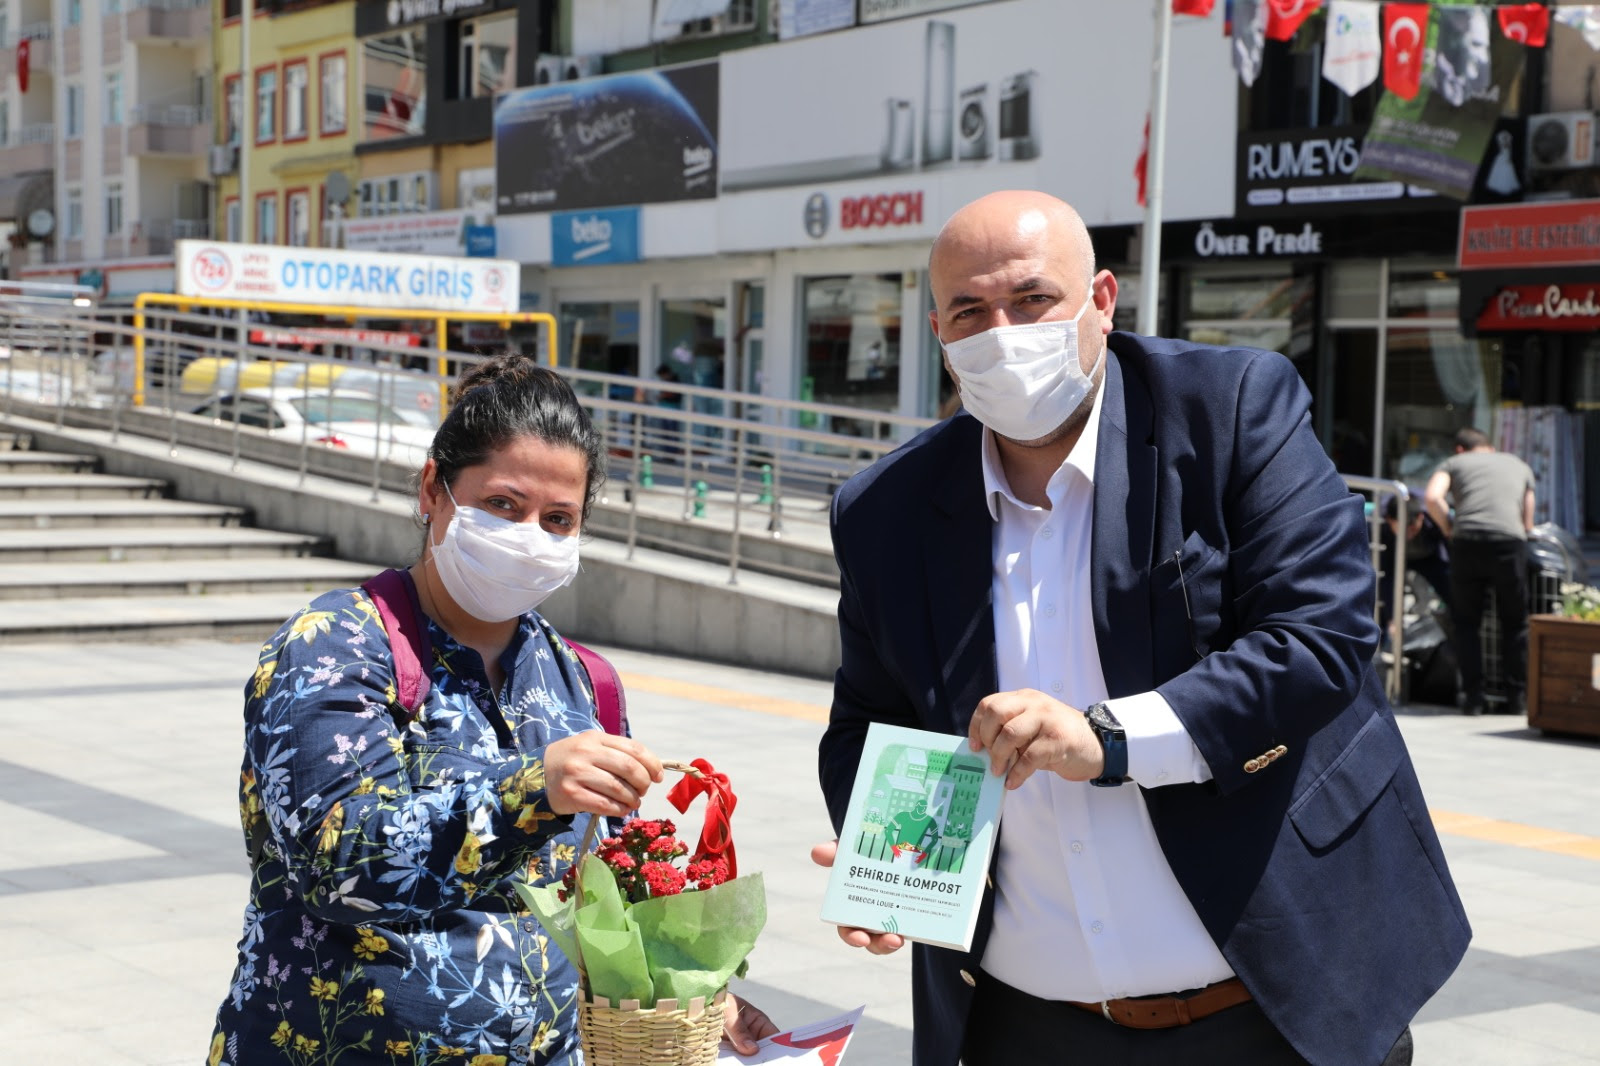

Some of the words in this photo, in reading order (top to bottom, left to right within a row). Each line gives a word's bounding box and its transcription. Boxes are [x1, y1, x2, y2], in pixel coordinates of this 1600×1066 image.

[840, 190, 923, 231] BOSCH
[571, 214, 613, 243] beko
[282, 259, 402, 294] OTOPARK
[409, 262, 473, 303] GİRİŞ
[848, 866, 899, 884] ŞEHİRDE
[904, 876, 962, 895] KOMPOST
[847, 894, 876, 906] REBECCA
[876, 899, 895, 910] LOUIE
